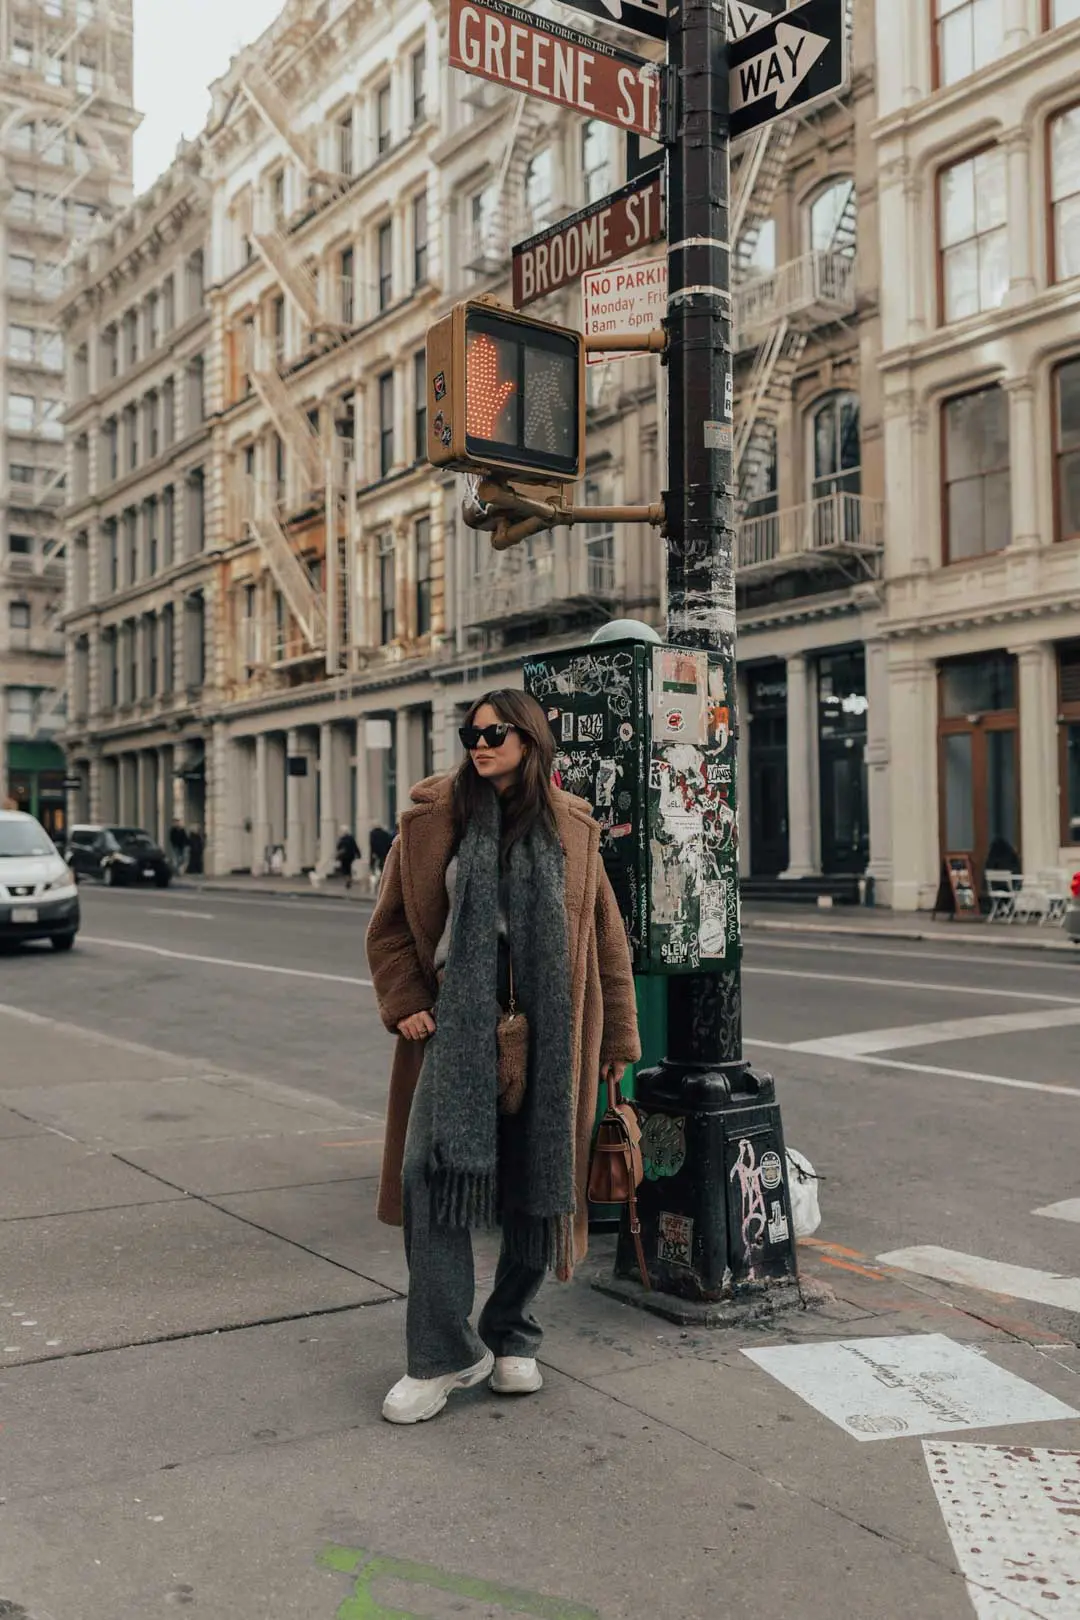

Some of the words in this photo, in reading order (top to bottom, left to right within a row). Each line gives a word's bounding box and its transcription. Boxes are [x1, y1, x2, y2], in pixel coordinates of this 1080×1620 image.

[511, 8, 534, 24] IRON
[535, 17, 576, 41] HISTORIC
[578, 34, 617, 57] DISTRICT
[459, 6, 595, 112] GREENE
[616, 67, 655, 132] ST
[739, 37, 805, 103] WAY
[521, 208, 612, 300] BROOME
[625, 185, 653, 247] ST
[591, 279, 611, 297] NO
[591, 298, 635, 317] Monday
[592, 319, 616, 334] 8am
[628, 311, 654, 328] 6pm
[661, 942, 689, 957] SLEW
